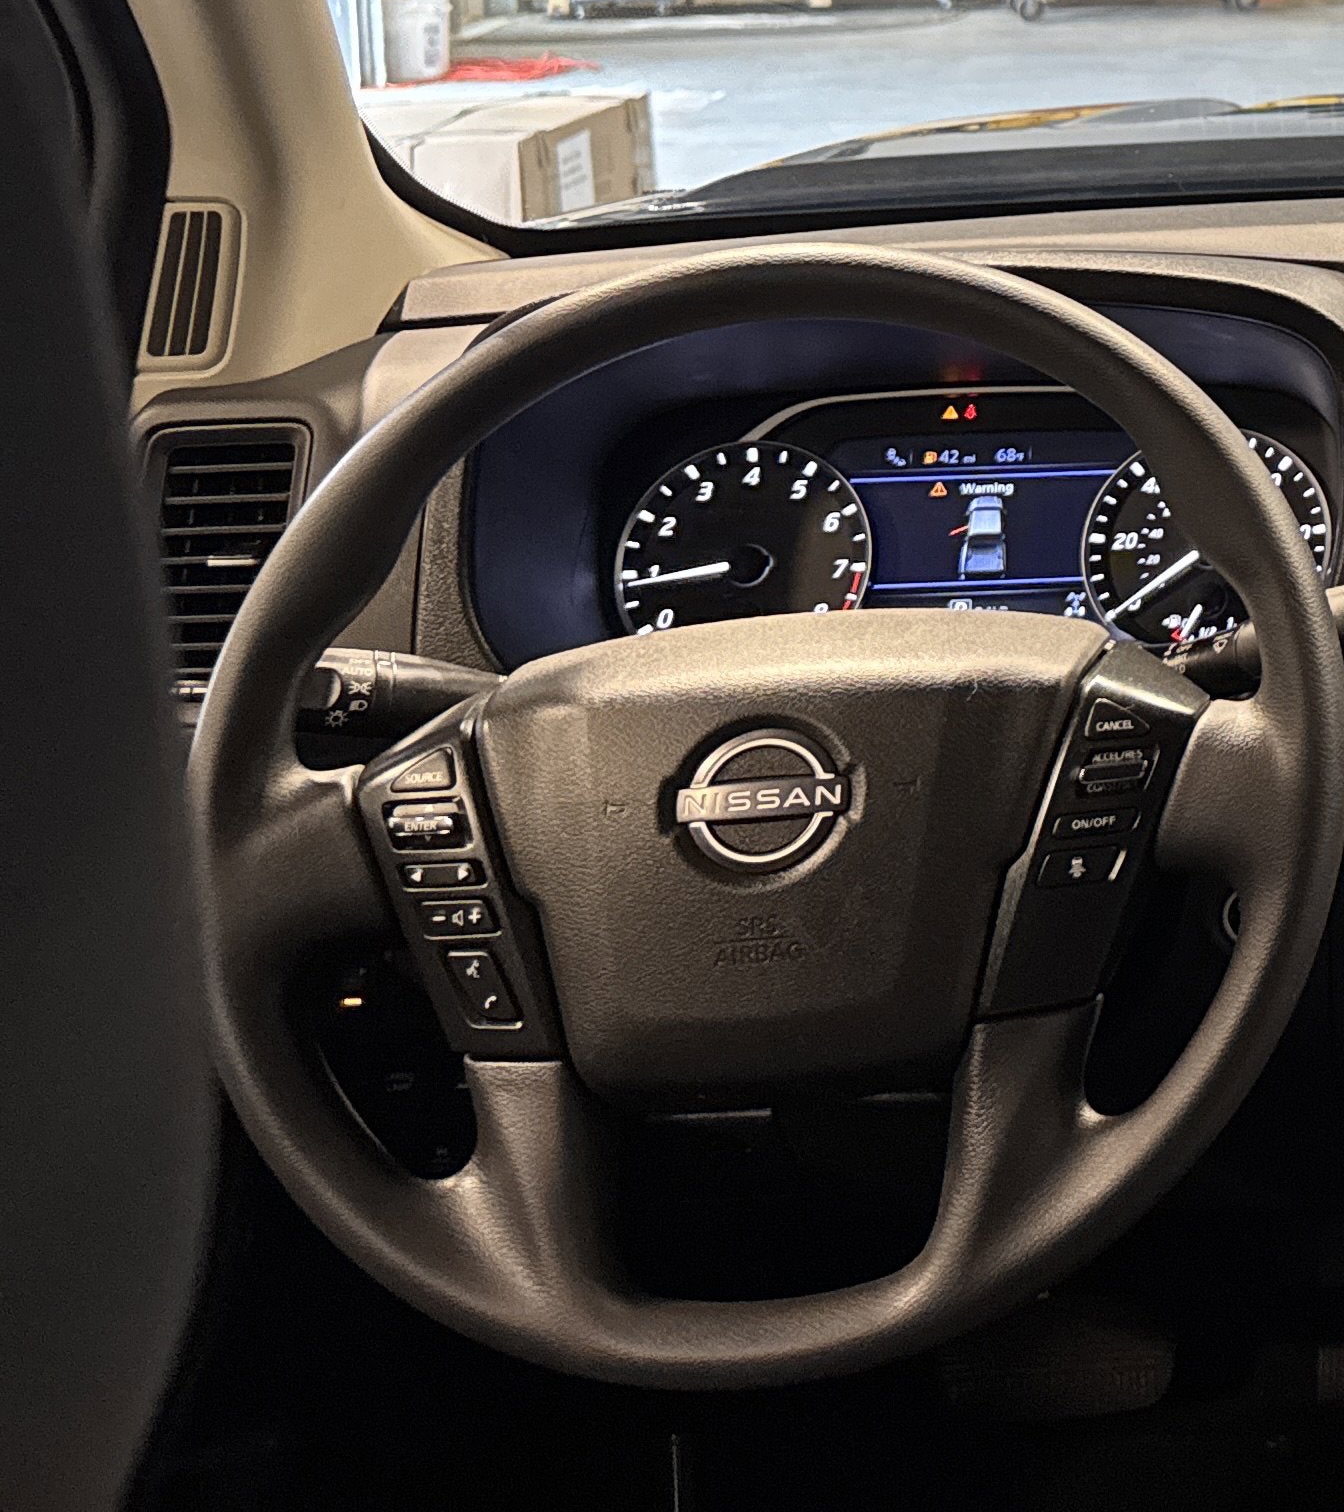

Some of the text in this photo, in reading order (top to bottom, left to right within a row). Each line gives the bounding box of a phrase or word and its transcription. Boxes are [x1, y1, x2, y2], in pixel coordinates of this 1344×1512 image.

[939, 448, 960, 464] 42
[742, 466, 761, 487] 4
[695, 480, 715, 502] 3
[789, 479, 809, 501] 5
[959, 481, 1015, 497] Warning
[657, 516, 677, 537] 2
[823, 511, 841, 533] 6
[1111, 531, 1139, 551] 20
[832, 557, 850, 579] 7
[656, 608, 675, 624] 0
[1095, 719, 1135, 732] CANCEL
[404, 771, 444, 785] SOURCE
[683, 784, 842, 816] NISSAN
[404, 821, 438, 832] ENTER
[1071, 815, 1117, 830] ON/OFF
